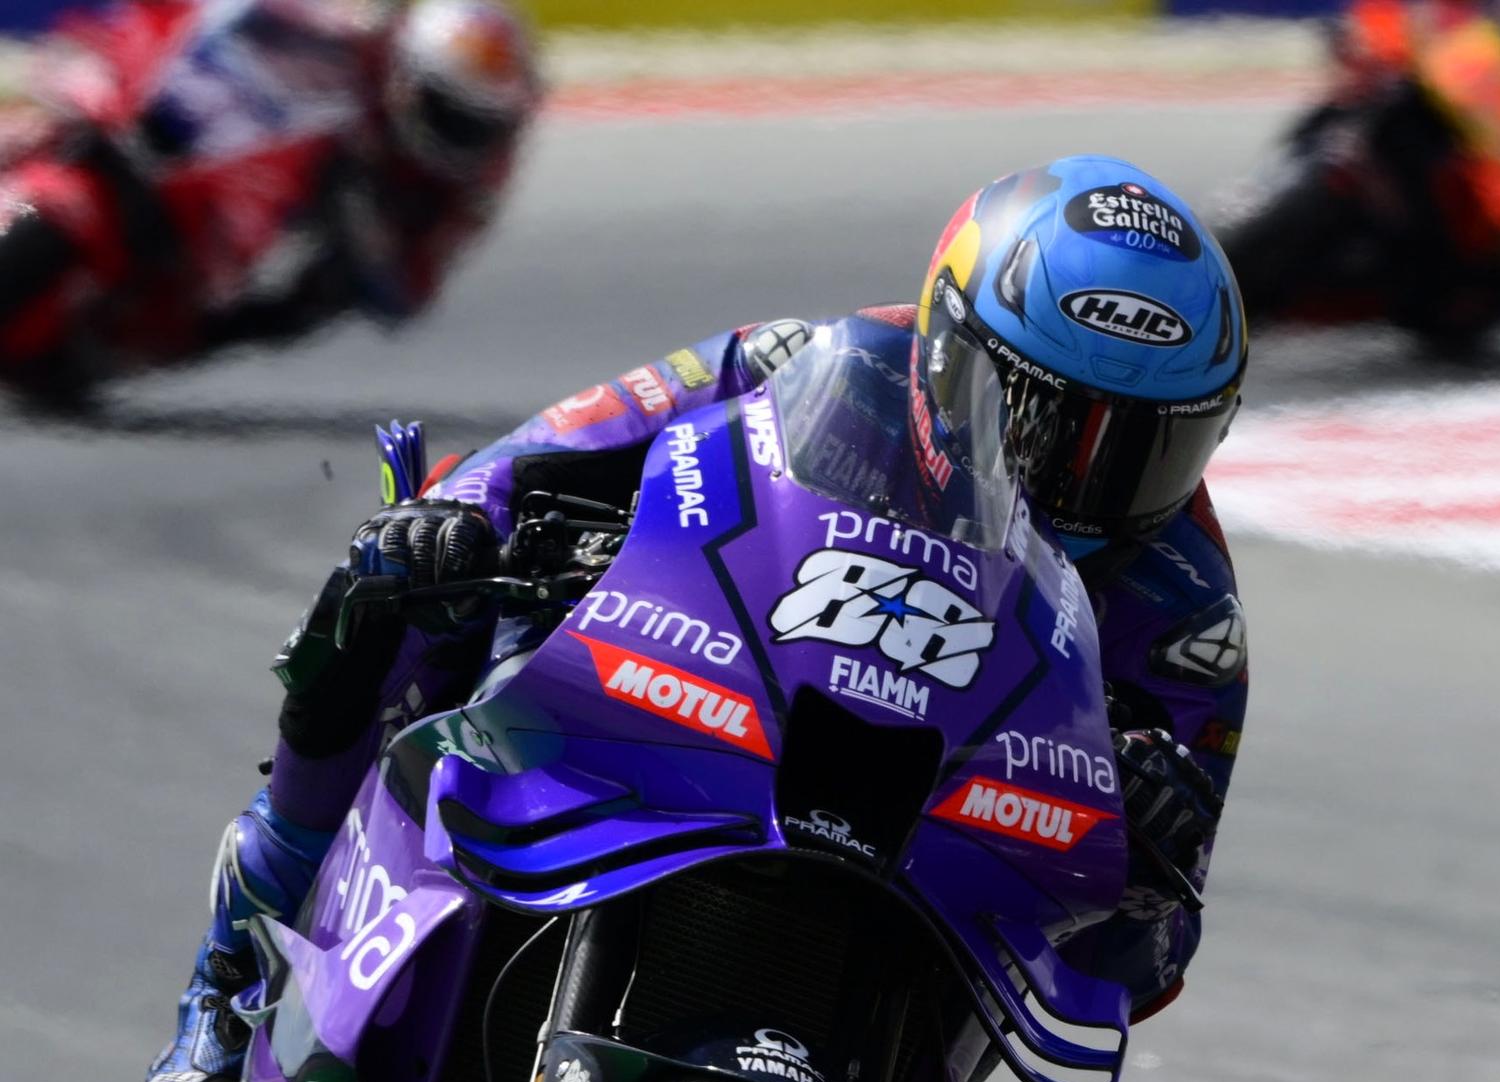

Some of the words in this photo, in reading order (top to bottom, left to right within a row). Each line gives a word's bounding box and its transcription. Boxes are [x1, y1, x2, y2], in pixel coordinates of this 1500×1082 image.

[1088, 192, 1183, 231] Estrella
[1093, 207, 1180, 247] Galicia
[1077, 297, 1180, 340] HJC
[624, 366, 669, 411] TUL
[999, 345, 1067, 391] PRAMAC
[1170, 395, 1223, 415] PRAMAC
[665, 423, 708, 528] PRAMAC
[818, 511, 978, 591] prima
[1052, 518, 1103, 534] Cofidis
[586, 591, 743, 665] prima
[767, 548, 997, 690] 88
[606, 659, 751, 738] MOTUL
[830, 655, 930, 716] FIAMM
[996, 730, 1115, 793] prima
[785, 816, 876, 857] PRAMAC
[960, 783, 1074, 843] MOTUL
